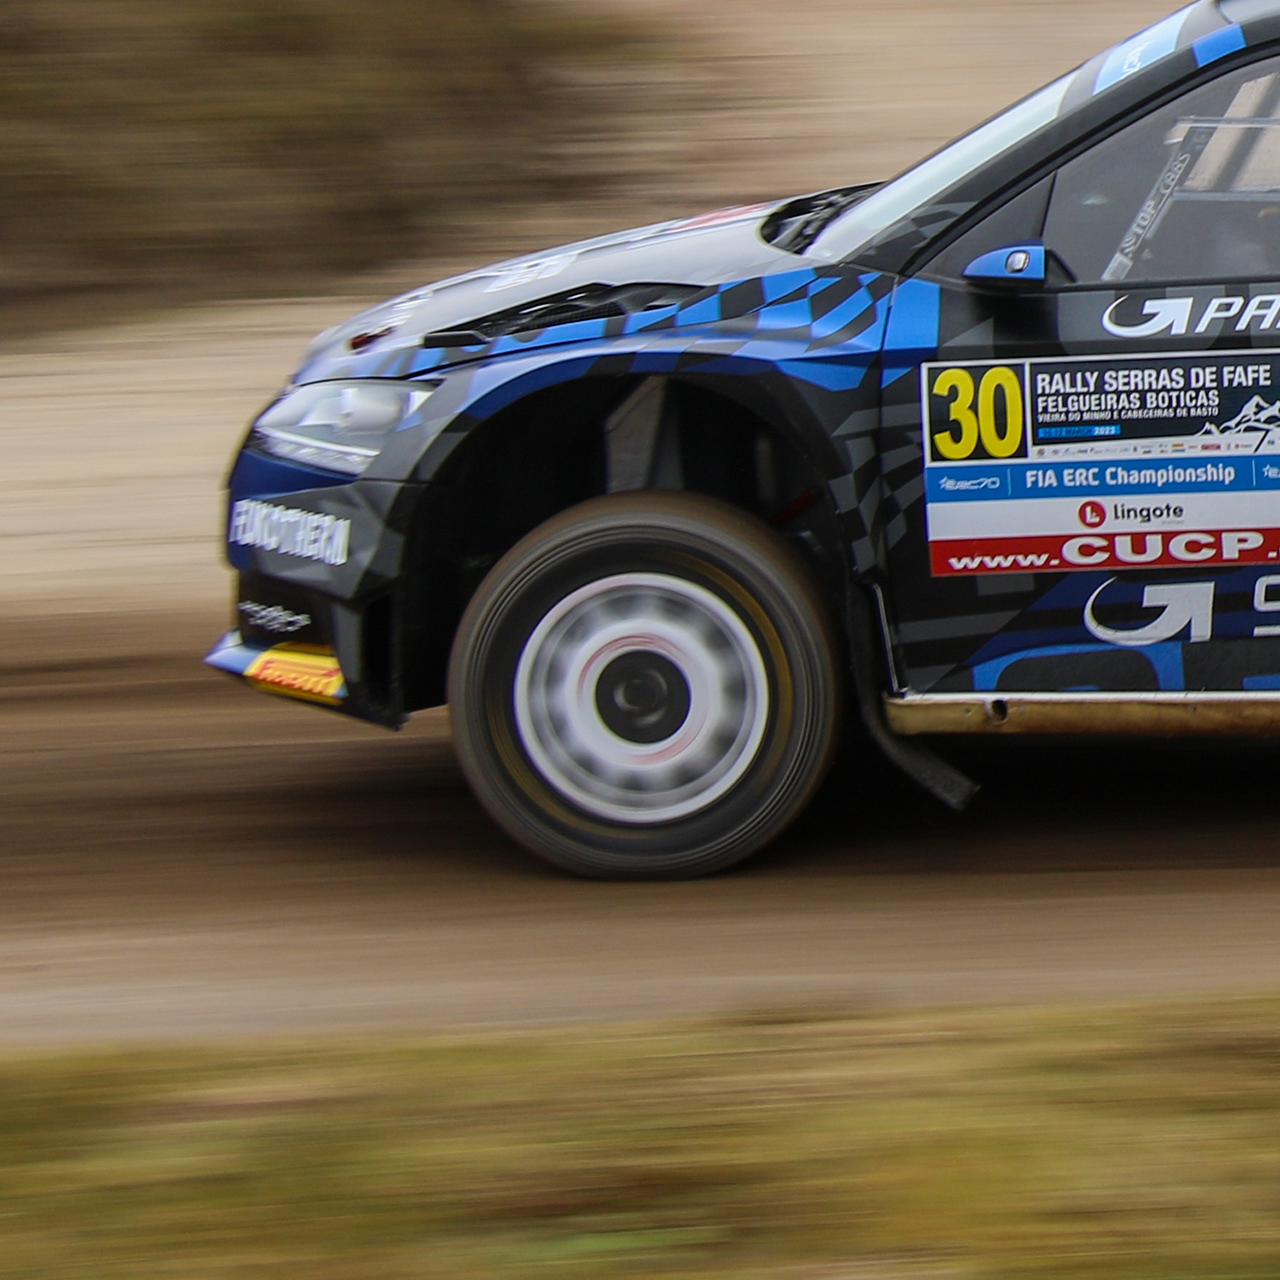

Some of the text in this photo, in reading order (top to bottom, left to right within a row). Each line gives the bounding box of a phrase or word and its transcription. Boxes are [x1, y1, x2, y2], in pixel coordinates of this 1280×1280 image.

[1036, 364, 1271, 395] RALLY SERRAS DE FAFE
[932, 365, 1024, 460] 30
[1037, 389, 1220, 413] FELGUEIRAS BOTICAS
[1037, 406, 1219, 423] VIEIRA DO MINHO E CABECEIRAS DE BASTO
[1093, 426, 1116, 436] 2023
[1026, 463, 1236, 488] FIA ERC Championship
[1113, 503, 1184, 523] lingote
